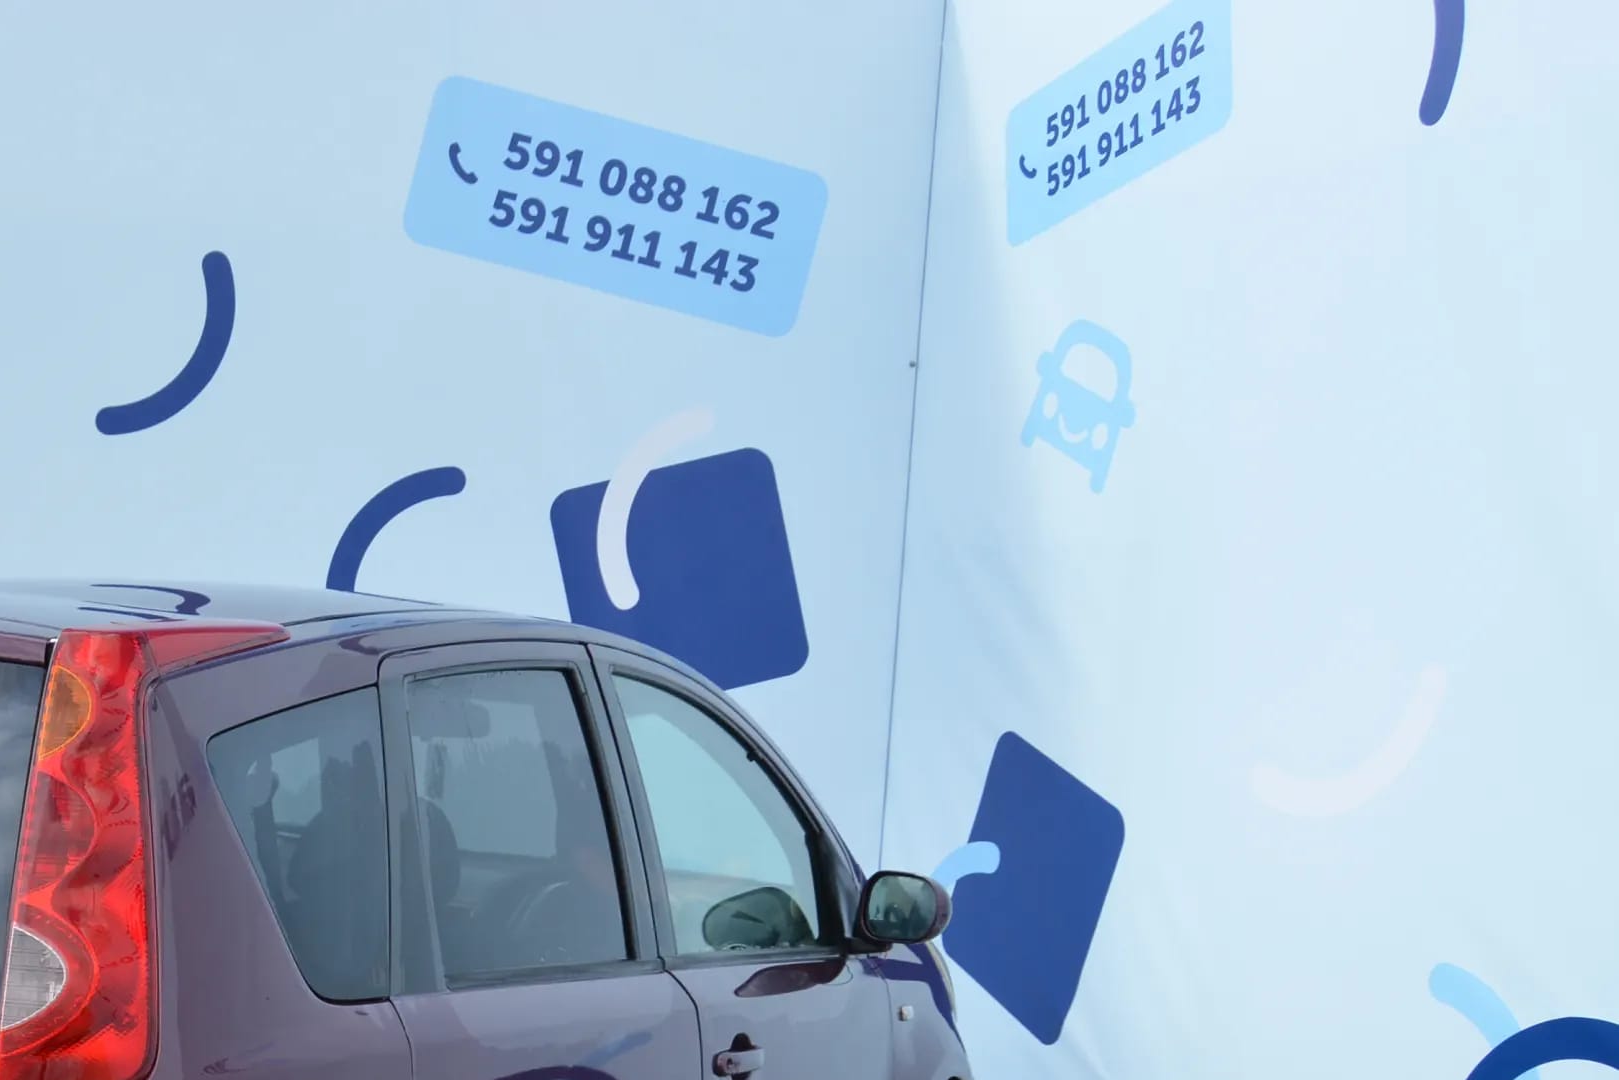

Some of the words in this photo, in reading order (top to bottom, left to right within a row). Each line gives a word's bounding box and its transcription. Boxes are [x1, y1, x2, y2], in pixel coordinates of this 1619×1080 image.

[1046, 94, 1090, 147] 591
[1097, 58, 1147, 115] 088
[1154, 21, 1205, 81] 162
[1047, 144, 1091, 196] 591
[1097, 112, 1144, 167] 911
[1151, 75, 1201, 136] 143
[488, 189, 570, 244] 591
[583, 215, 662, 269] 911
[674, 241, 759, 293] 143
[503, 132, 584, 187] 591
[599, 158, 686, 212] 088
[695, 185, 780, 239] 162
